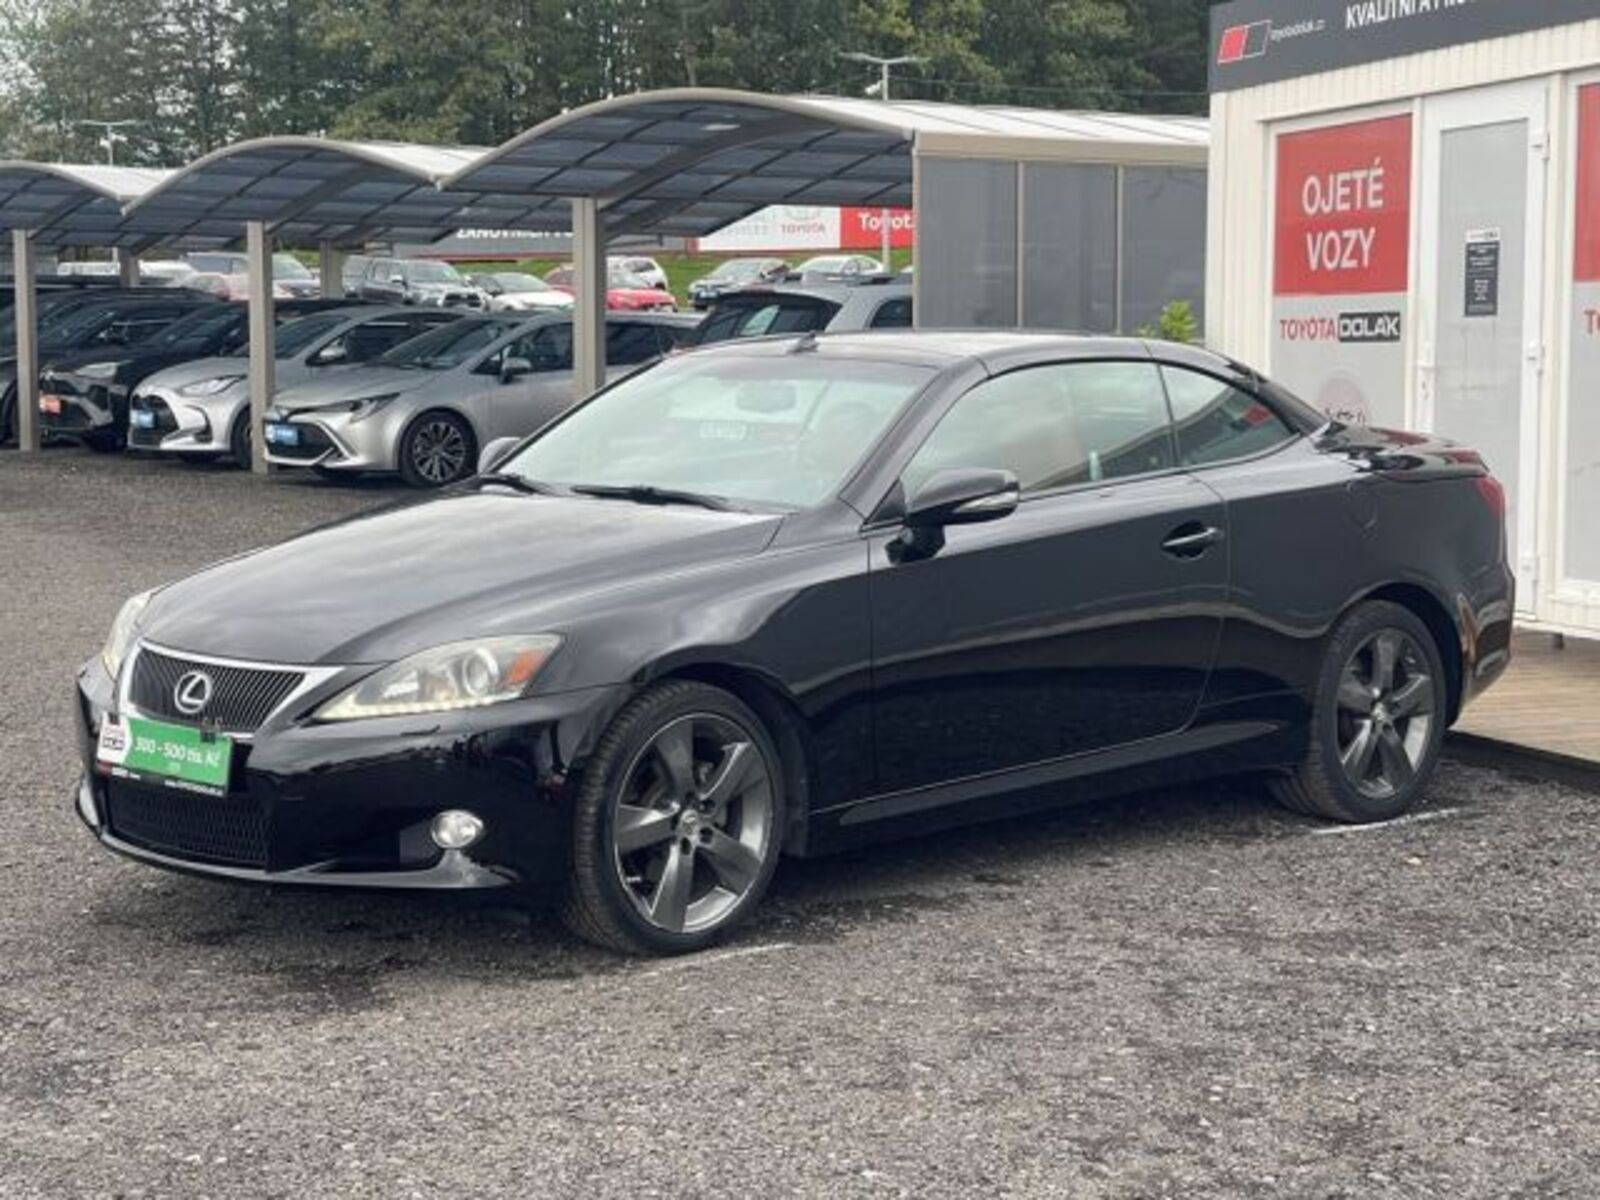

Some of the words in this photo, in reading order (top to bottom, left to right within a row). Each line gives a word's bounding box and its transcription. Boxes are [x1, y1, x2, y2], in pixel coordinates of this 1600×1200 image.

[1302, 156, 1384, 216] OJETÉ
[1306, 226, 1376, 271] VOZY
[1280, 317, 1336, 340] TOYOTA
[1339, 314, 1400, 338] DOLAK
[163, 741, 186, 761] 500
